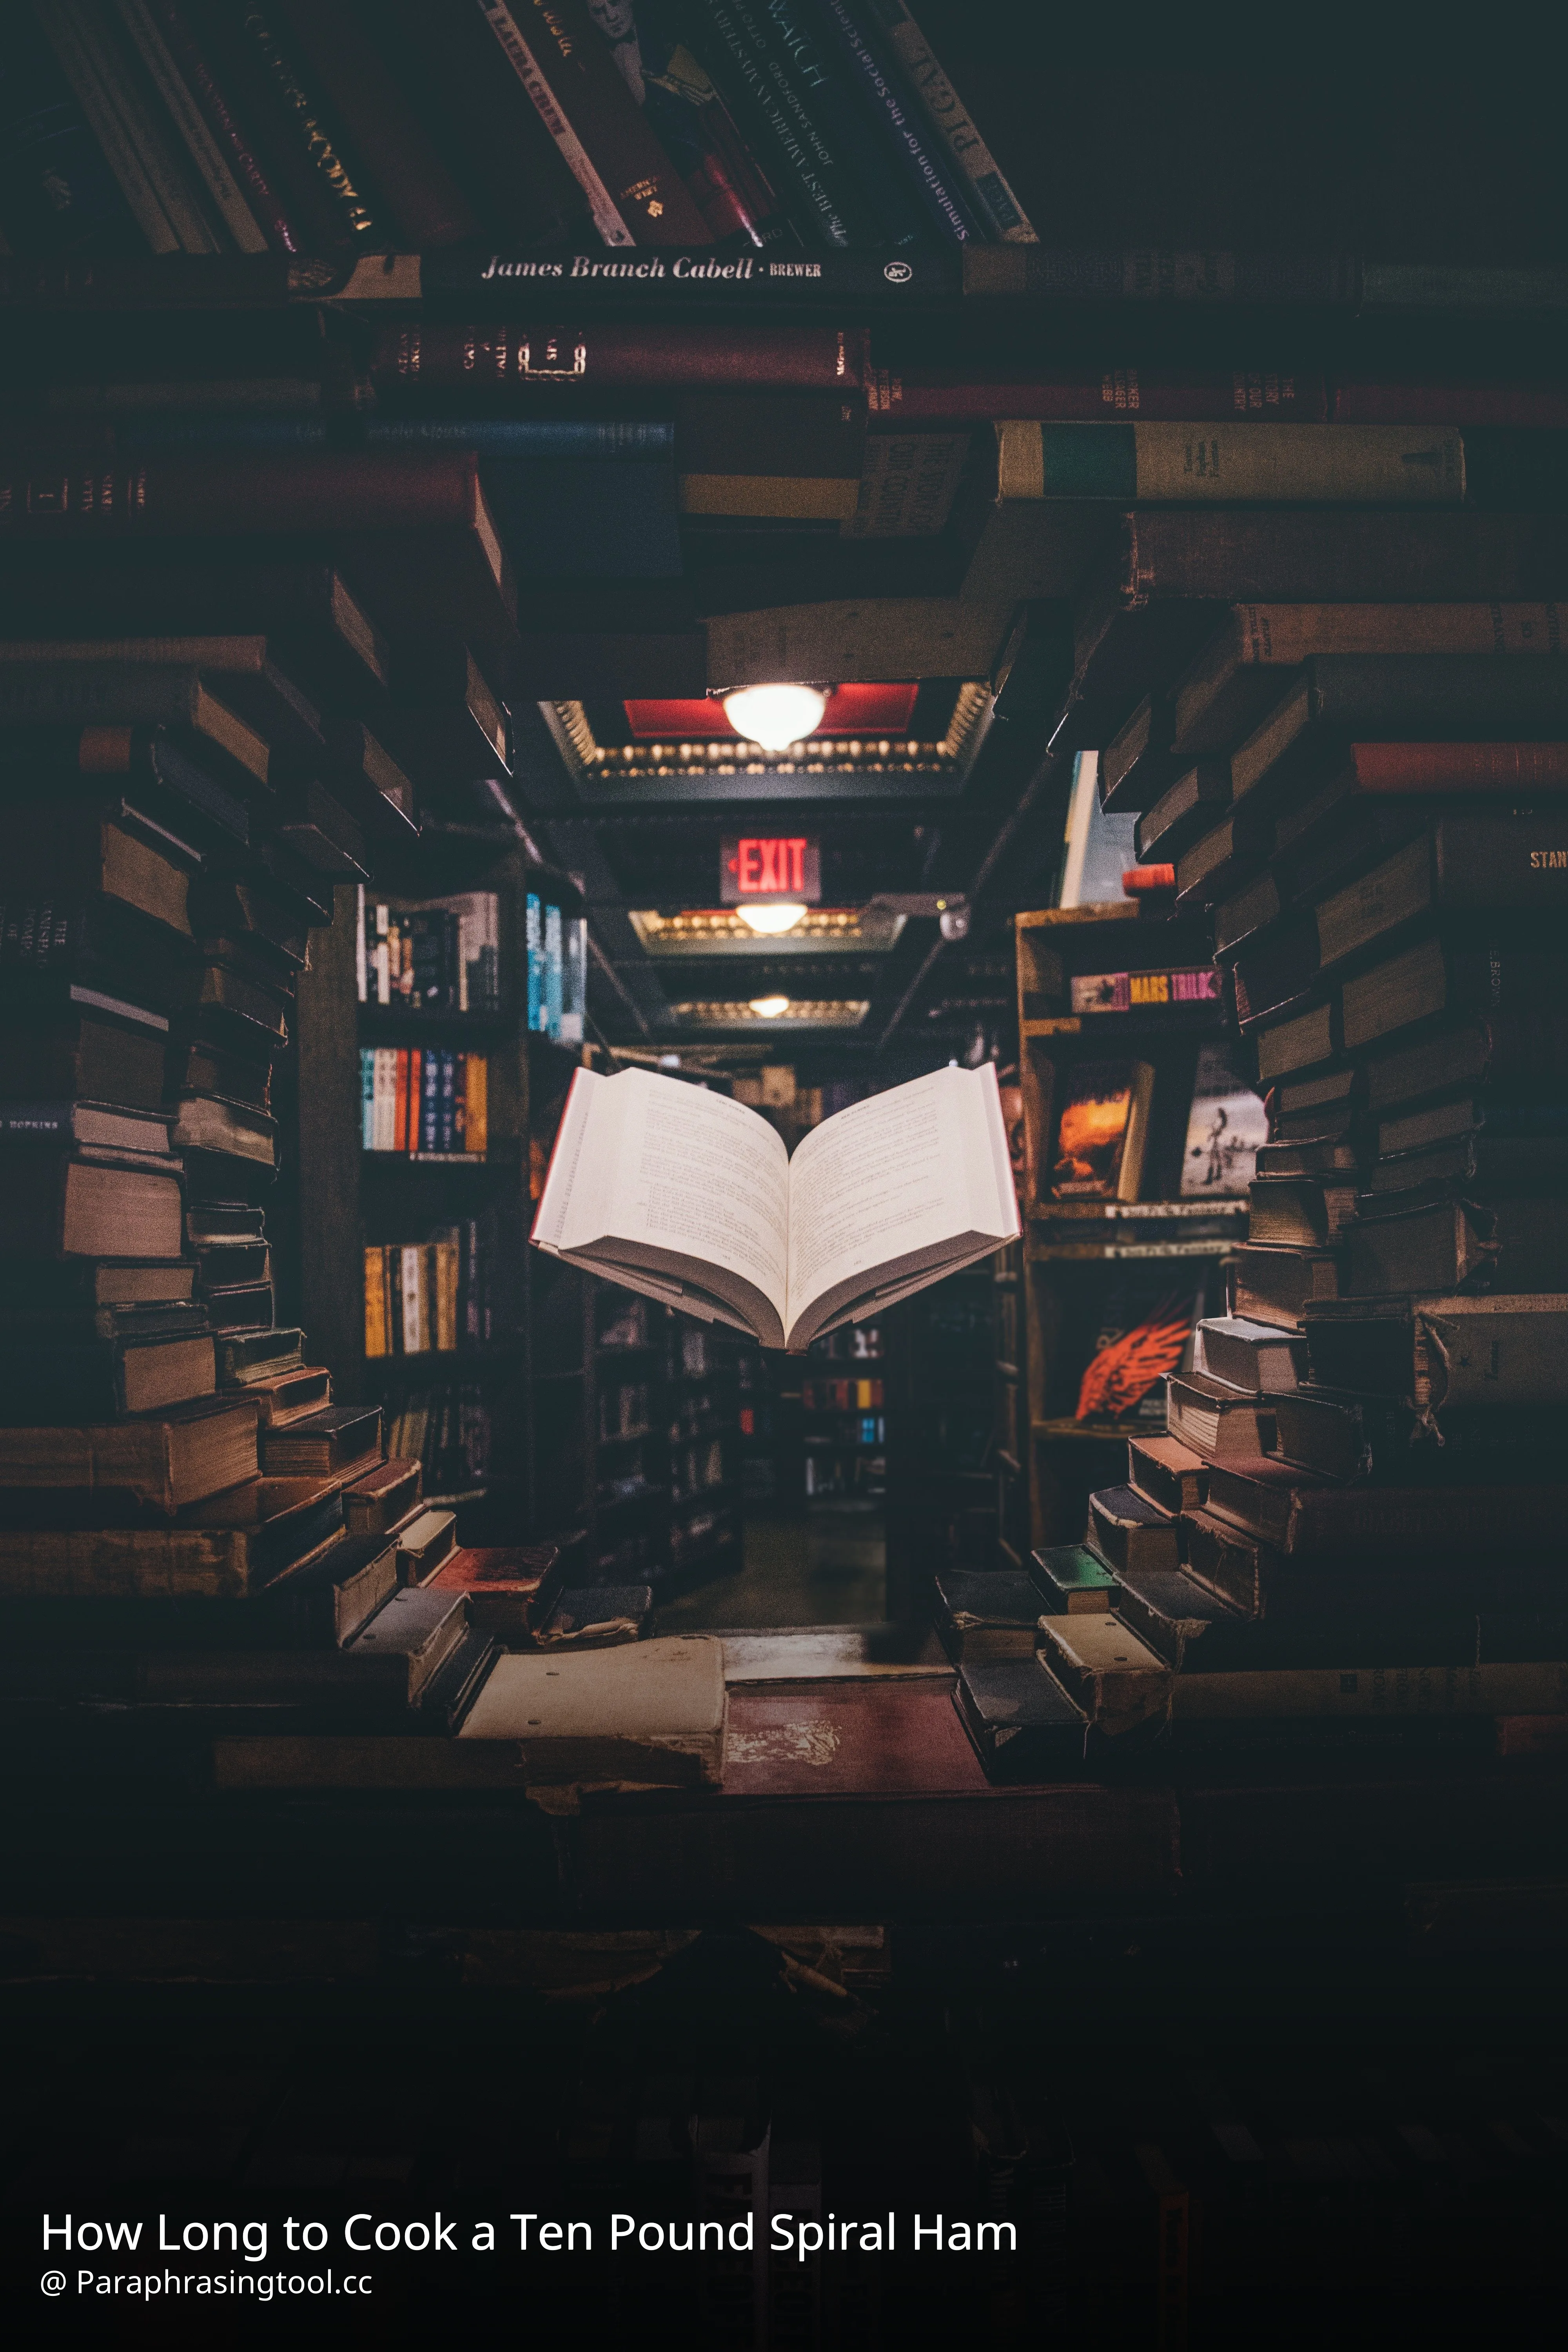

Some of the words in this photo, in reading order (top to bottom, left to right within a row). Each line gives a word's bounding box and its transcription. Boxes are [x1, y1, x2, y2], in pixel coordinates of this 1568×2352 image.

[710, 4, 762, 83] MYSTERY
[763, 0, 833, 89] WATCH
[855, 47, 891, 98] Social
[766, 58, 813, 130] SANDFORD
[882, 95, 907, 127] the
[752, 81, 810, 170] AMERICAN
[899, 127, 923, 156] for
[806, 129, 834, 168] JOHN
[800, 168, 833, 213] BEST
[913, 153, 971, 242] Simulation
[823, 209, 848, 240] The
[481, 259, 563, 279] James
[570, 257, 665, 279] Branch
[672, 257, 753, 279] Cabell
[769, 263, 822, 278] BREWER
[1249, 387, 1262, 409] OUR
[1265, 373, 1279, 405] STORY
[1282, 377, 1296, 399] THE
[739, 838, 807, 893] EXIT
[53, 919, 67, 947] THE
